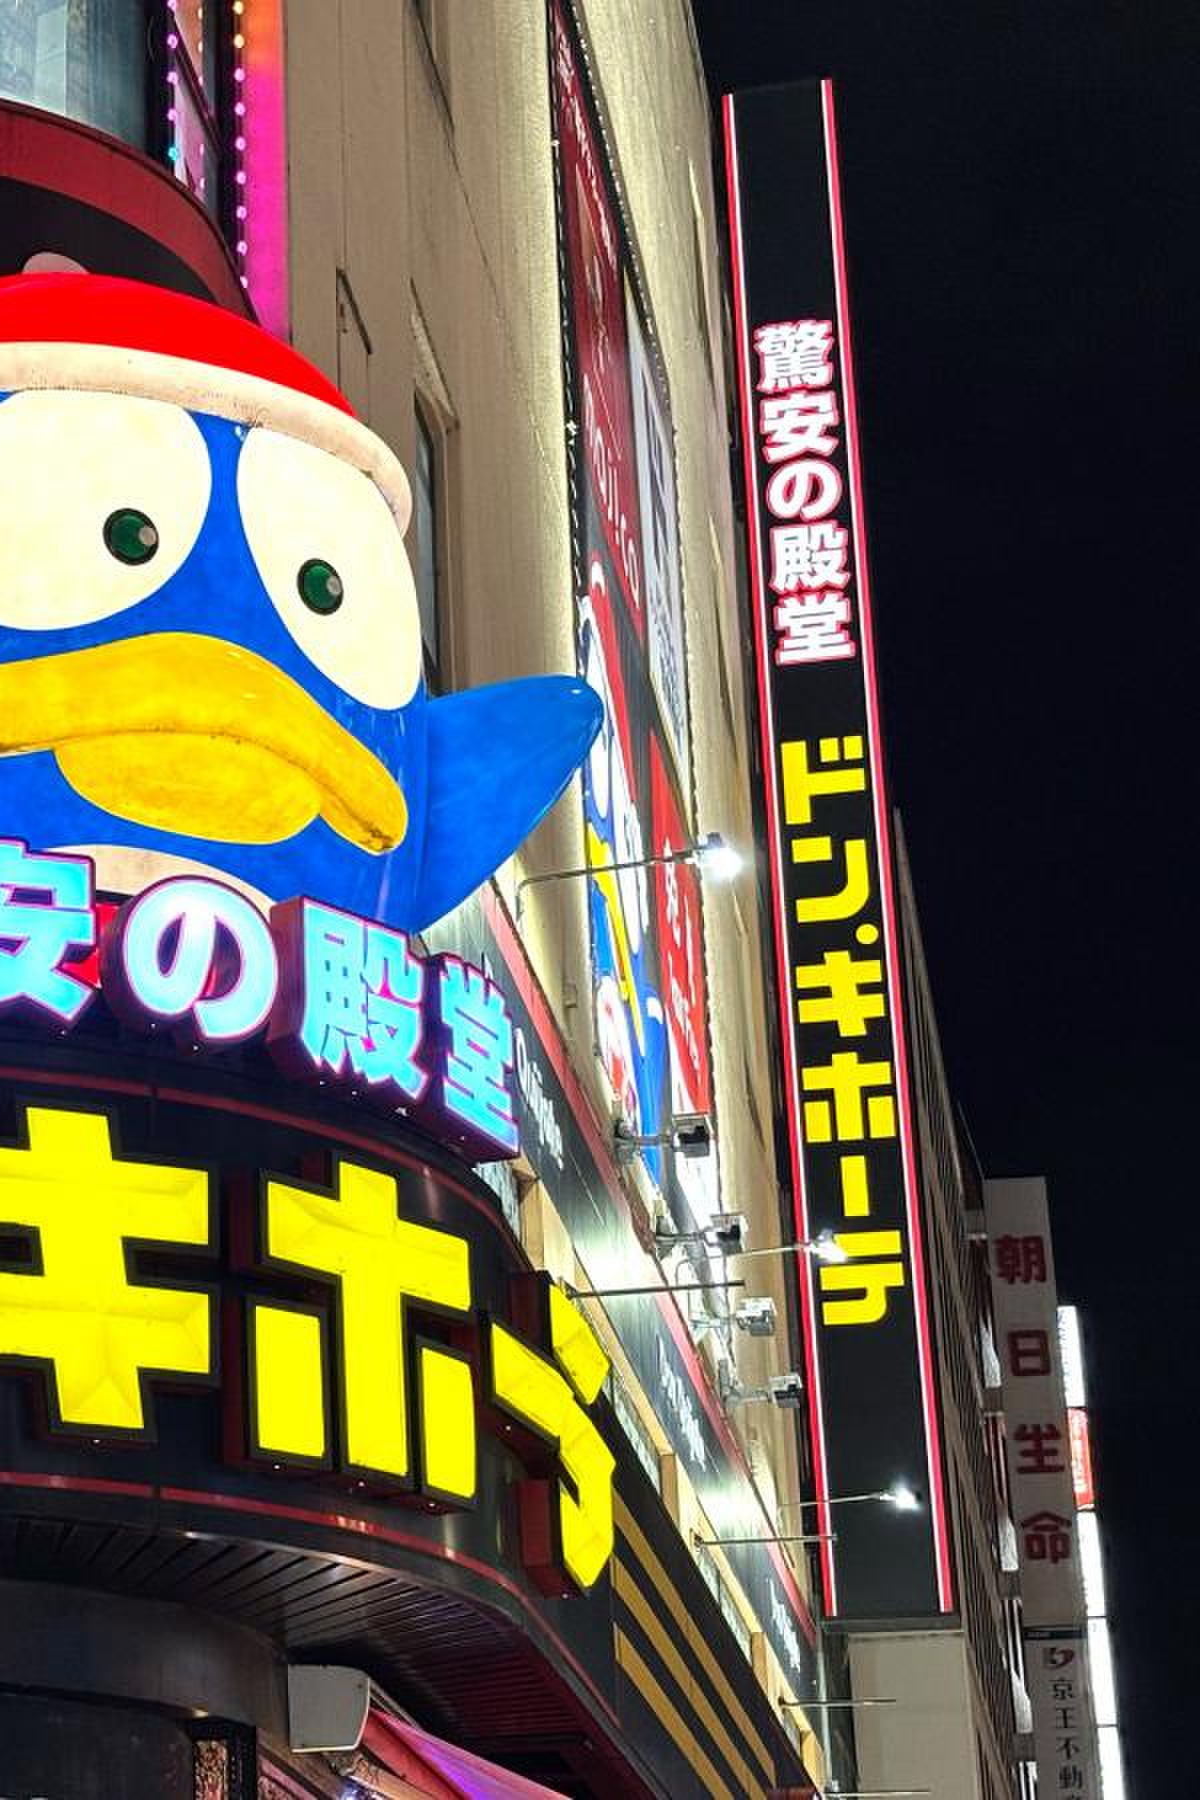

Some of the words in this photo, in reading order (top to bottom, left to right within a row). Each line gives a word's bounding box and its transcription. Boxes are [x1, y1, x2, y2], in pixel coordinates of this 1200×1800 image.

[753, 319, 856, 665] 驚安の殿堂
[995, 1235, 1072, 1564] 朝日生命
[1048, 1677, 1084, 1800] 京王不動
